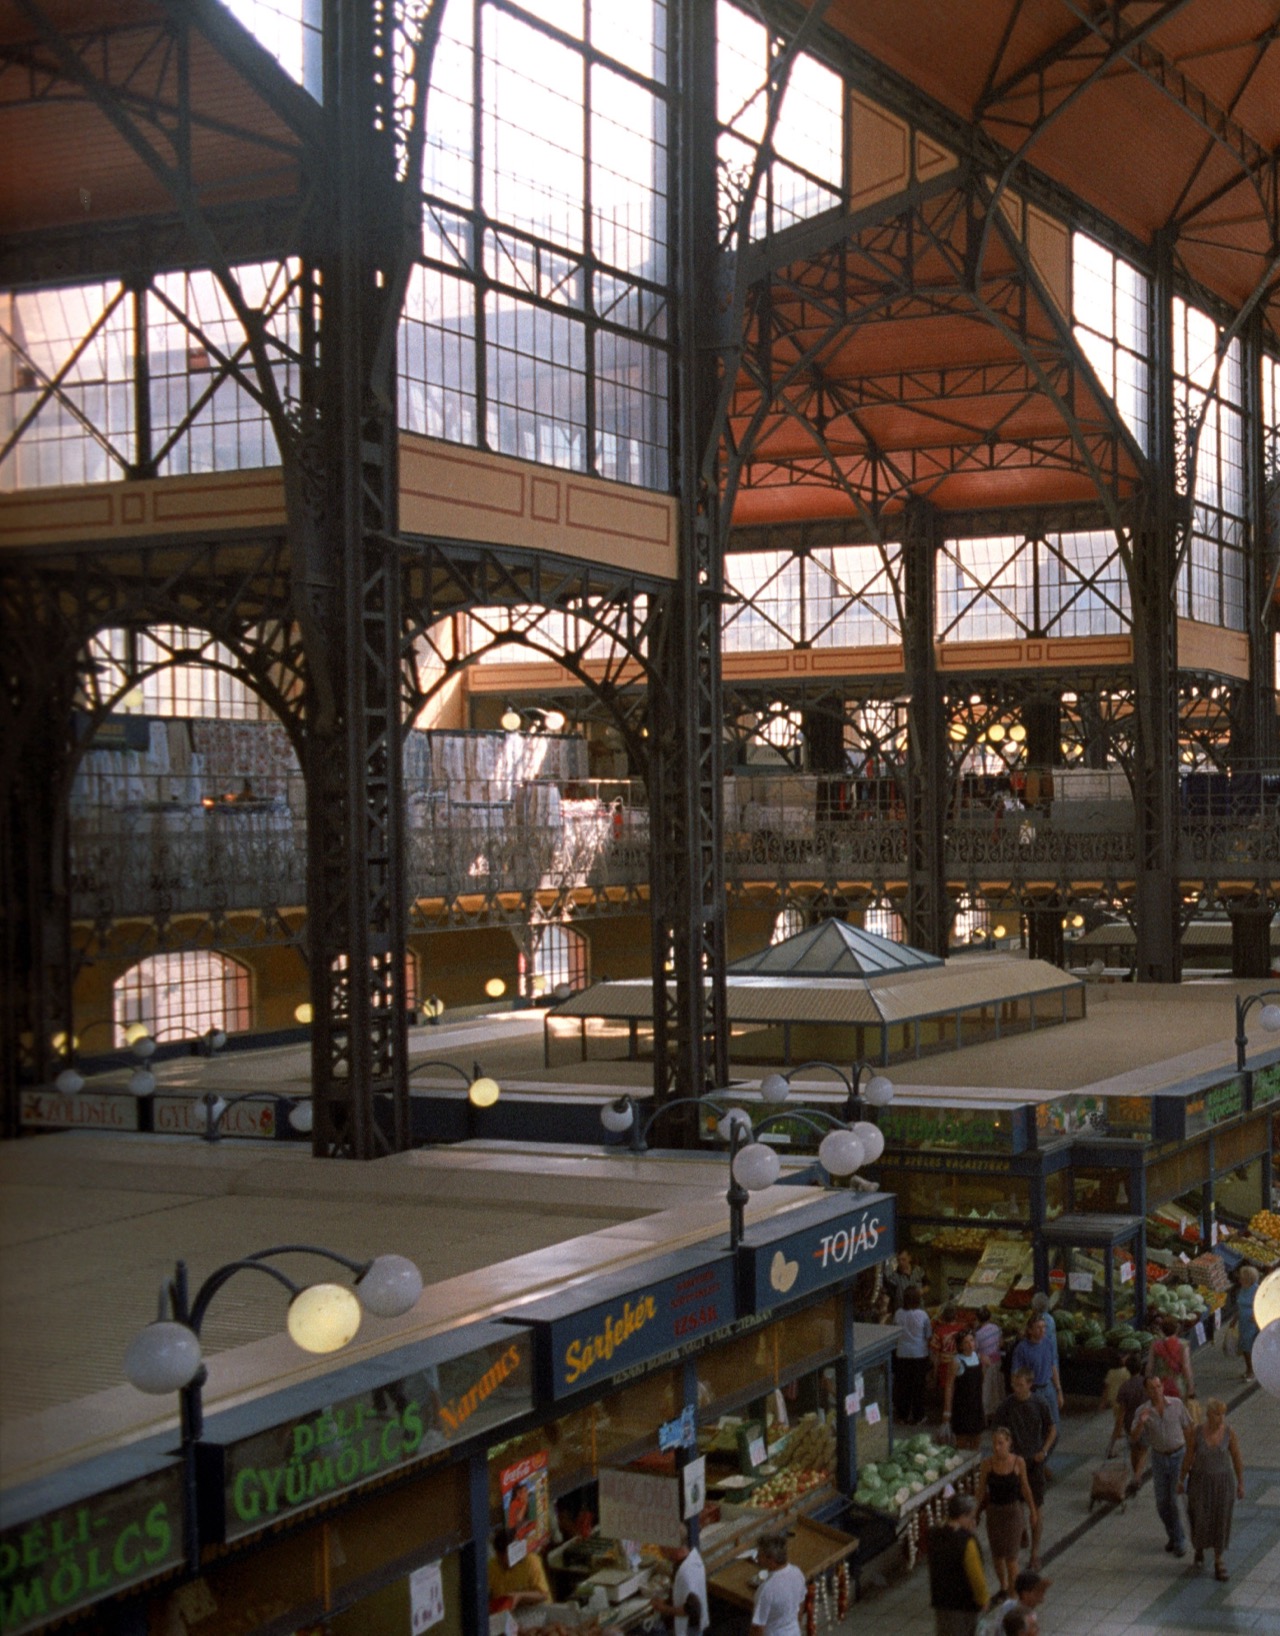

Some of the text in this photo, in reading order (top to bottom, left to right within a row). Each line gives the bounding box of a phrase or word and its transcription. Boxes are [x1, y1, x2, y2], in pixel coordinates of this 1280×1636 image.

[819, 1211, 881, 1268] TOJÁS
[439, 1345, 520, 1440] Narancs
[232, 1401, 424, 1522] GYÜMÖLCS
[0, 1500, 173, 1629] MÖLCS
